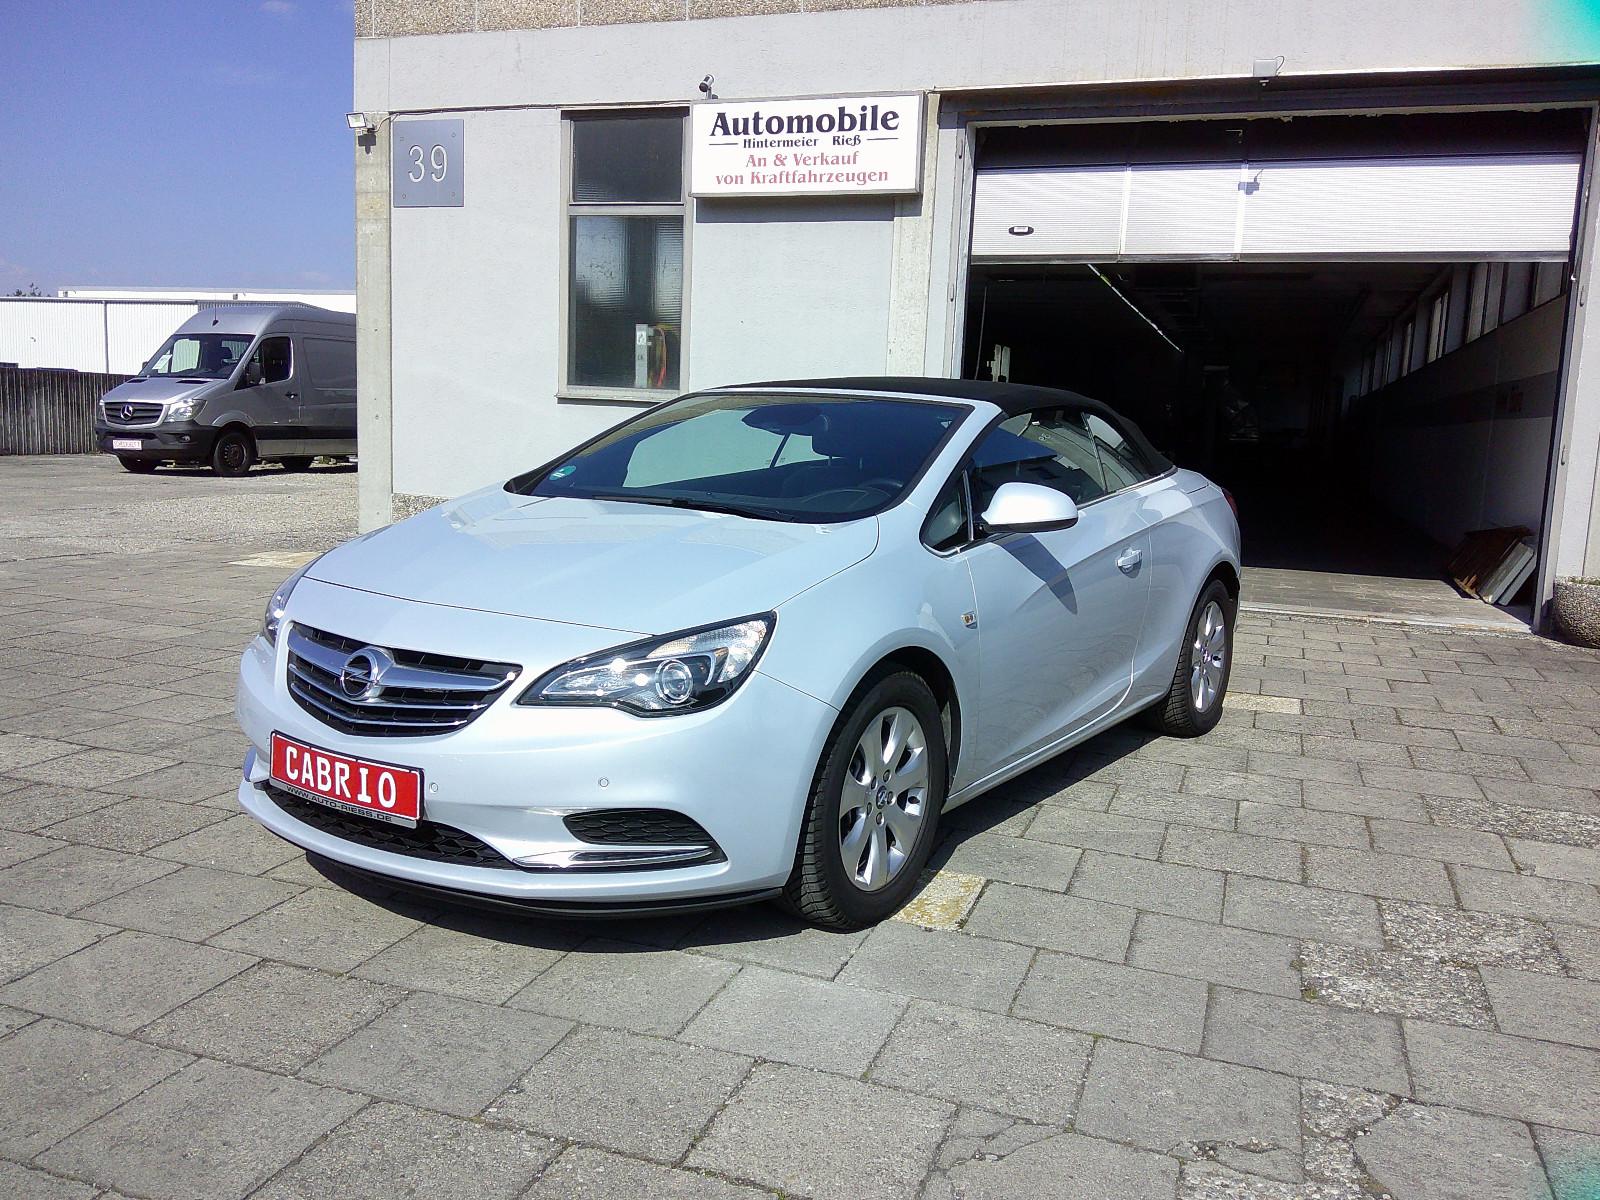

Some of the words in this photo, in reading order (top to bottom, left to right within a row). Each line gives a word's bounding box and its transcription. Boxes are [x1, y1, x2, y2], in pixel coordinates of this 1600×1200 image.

[709, 104, 900, 137] Automobile
[743, 137, 819, 149] Hintermeier
[832, 134, 862, 147] Rieß
[408, 144, 447, 182] 39
[746, 153, 767, 168] An
[773, 153, 788, 167] &
[793, 151, 860, 167] Verkauf
[715, 174, 744, 185] von
[750, 169, 889, 186] Kraftfahrzeugen
[285, 745, 397, 808] CABRIO
